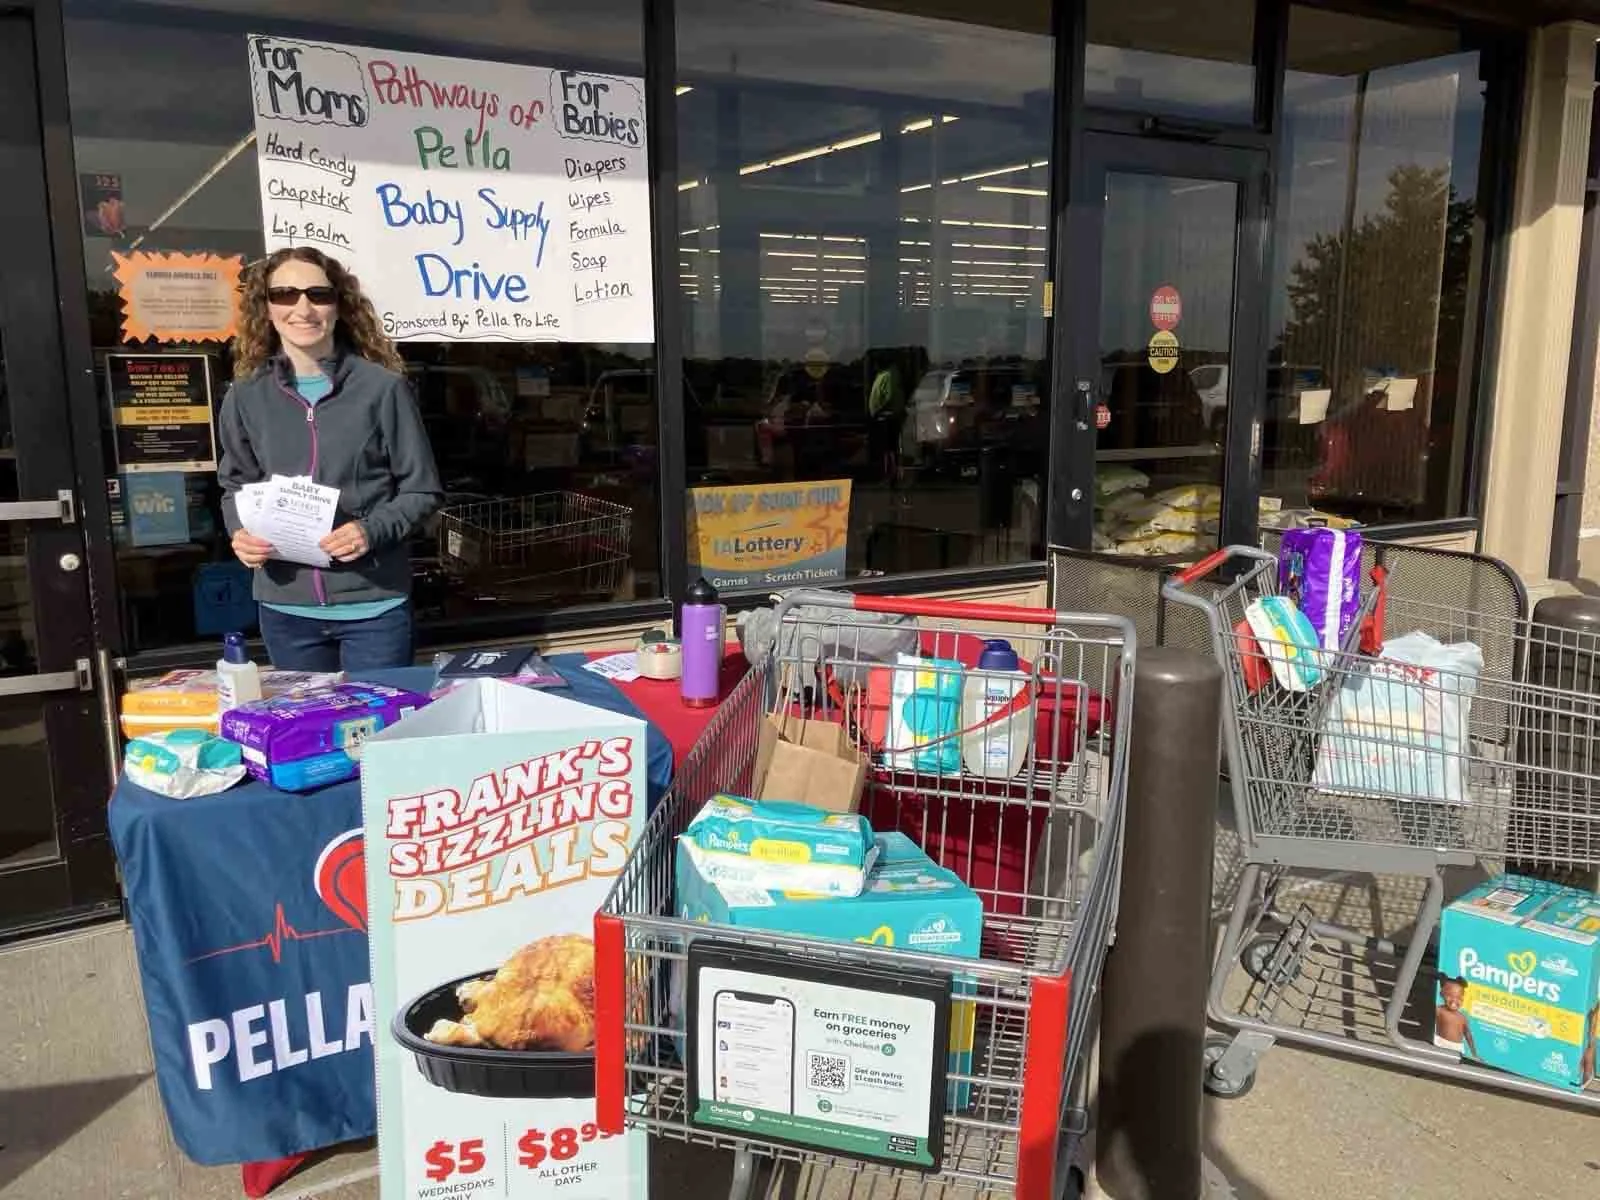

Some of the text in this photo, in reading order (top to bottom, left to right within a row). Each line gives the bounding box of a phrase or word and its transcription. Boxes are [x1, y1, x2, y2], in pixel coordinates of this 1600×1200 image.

[256, 38, 303, 71] For
[267, 70, 366, 126] Moms
[368, 60, 545, 144] Pathways of
[560, 71, 610, 107] For
[562, 104, 640, 145] Babies
[265, 132, 356, 187] Hard Candy
[414, 126, 511, 171] Pella
[564, 157, 627, 183] Diapers
[267, 178, 352, 210] Chapstick
[568, 191, 611, 213] Wipes
[272, 213, 351, 247] Lip Balm
[376, 183, 551, 268] Baby Supply
[569, 218, 627, 241] Formula
[570, 251, 607, 272] Soap
[415, 253, 530, 303] Drive
[574, 279, 633, 302] Lotion
[383, 311, 447, 334] Sponsored
[475, 308, 508, 328] Pella
[513, 313, 532, 328] Pro
[535, 311, 560, 328] Life
[1151, 347, 1178, 356] CAUTION
[292, 481, 321, 494] BABY
[713, 576, 748, 588] Games
[765, 568, 838, 583] Scratch Tickets
[385, 736, 634, 838] FRANK'S
[389, 779, 634, 877] SIZZLING
[392, 821, 633, 922] DEALS
[1459, 946, 1561, 1003] Pampers
[187, 982, 376, 1090] PELLA
[813, 1008, 911, 1034] Earn FREE money
[825, 1022, 897, 1040] on groceries
[425, 1138, 487, 1183] $5
[539, 1162, 598, 1179] ALL OTHER
[418, 1178, 495, 1199] WEDNESDAYS
[554, 1174, 583, 1187] DAYS
